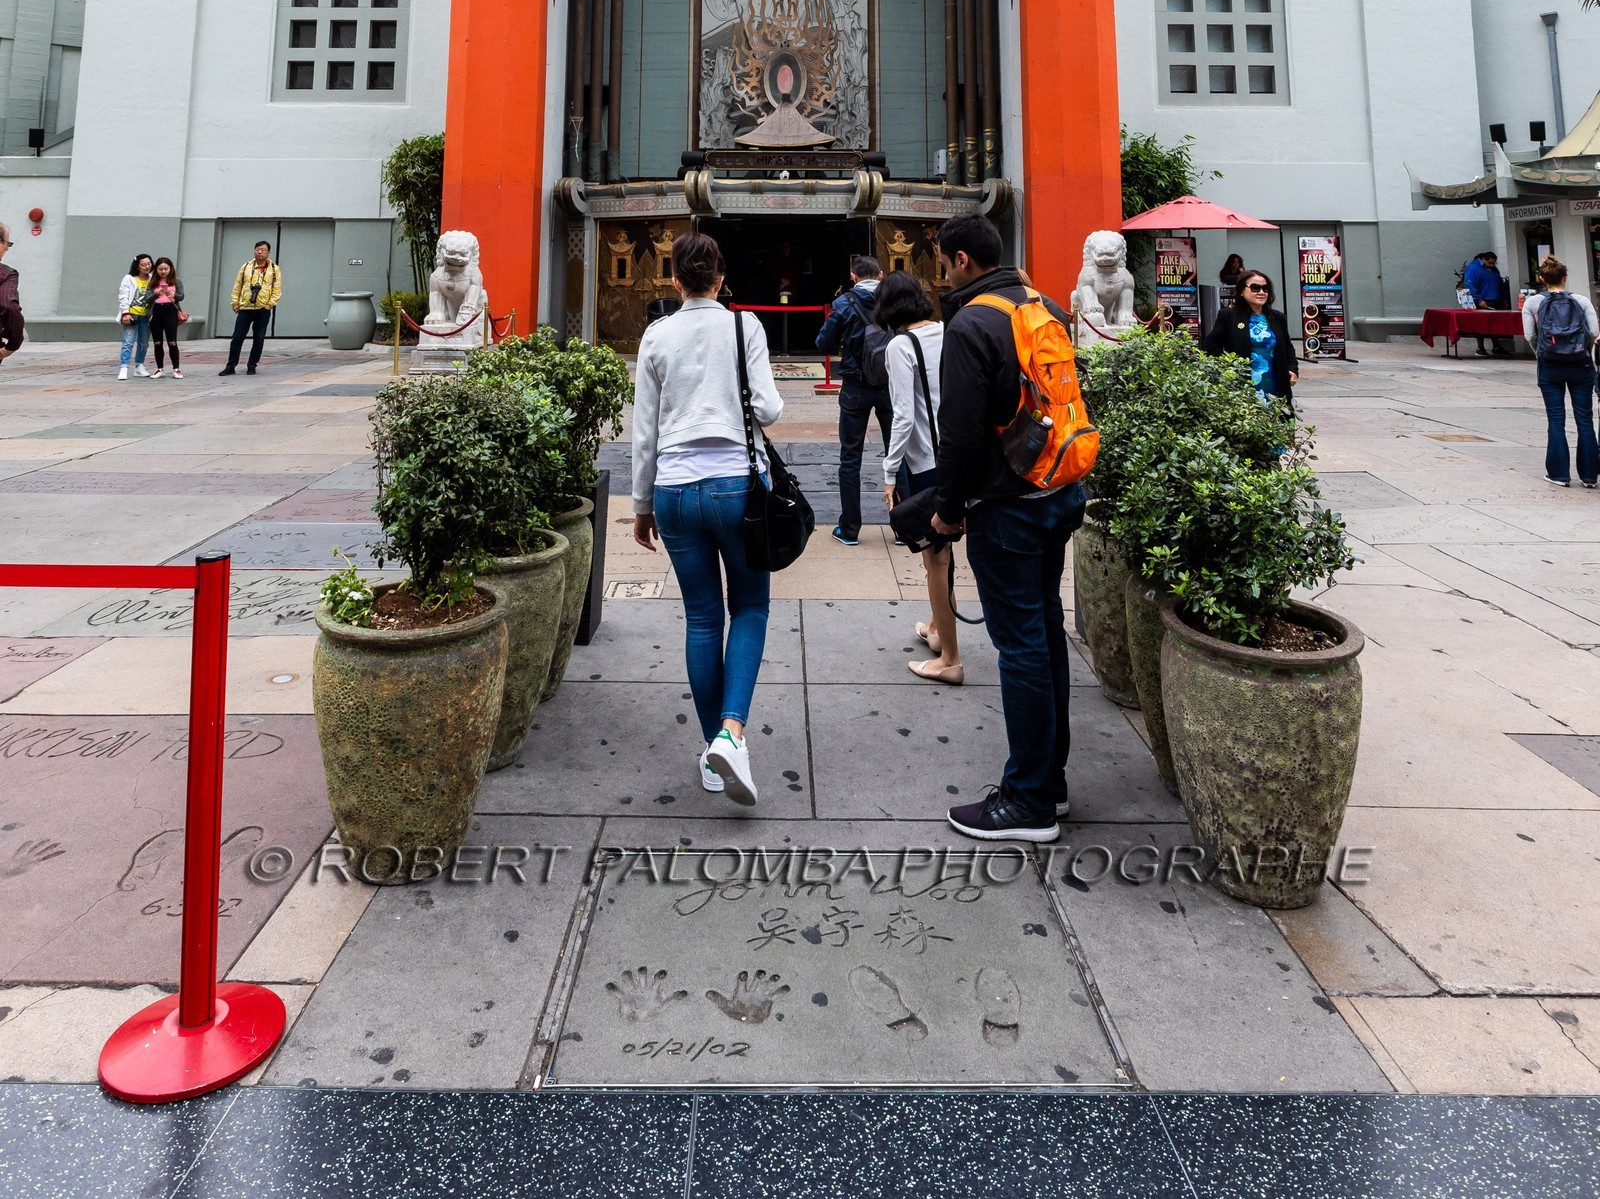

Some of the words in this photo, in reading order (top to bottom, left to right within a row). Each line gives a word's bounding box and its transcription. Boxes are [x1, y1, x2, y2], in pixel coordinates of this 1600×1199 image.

[1509, 205, 1554, 218] INFORMATION
[1159, 255, 1179, 265] TAKE
[1303, 254, 1324, 264] TAKE
[1160, 265, 1174, 275] THE
[1175, 265, 1189, 275] VIP
[1303, 263, 1319, 274] THE
[1319, 263, 1333, 274] VIP
[1160, 275, 1182, 285] TOUR
[1304, 273, 1326, 284] TOUR
[87, 598, 196, 627] Clint
[621, 1036, 752, 1063] 05/21/02
